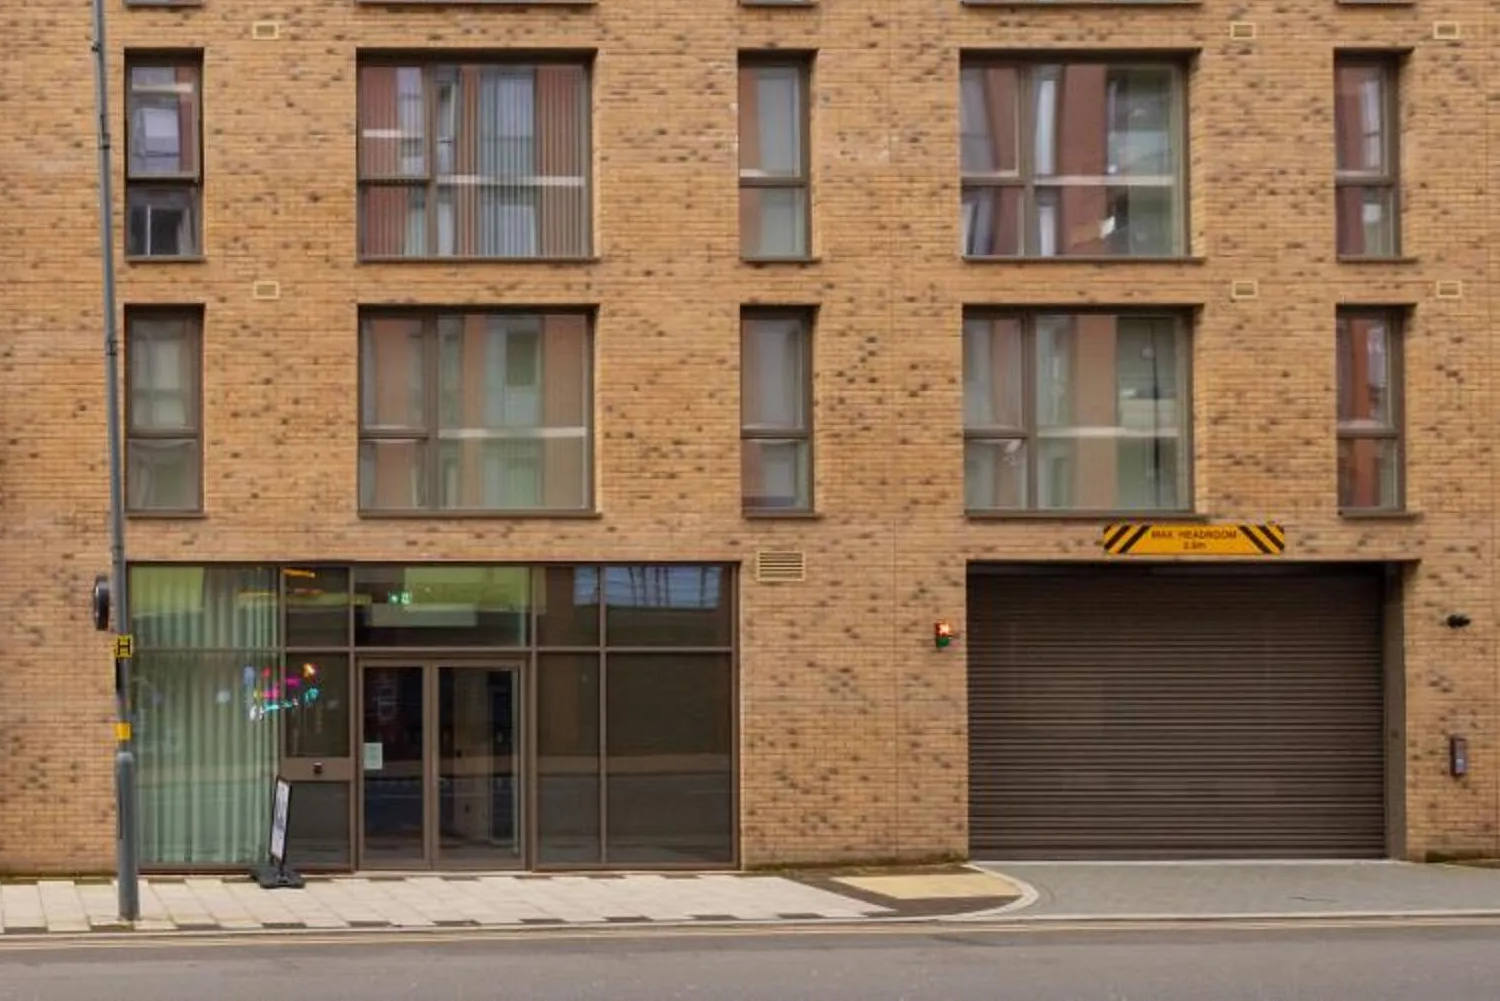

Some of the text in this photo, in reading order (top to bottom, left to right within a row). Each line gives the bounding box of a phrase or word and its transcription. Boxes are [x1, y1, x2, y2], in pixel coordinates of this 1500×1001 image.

[1151, 530, 1237, 539] MAX HEADROOM
[117, 638, 131, 656] H
